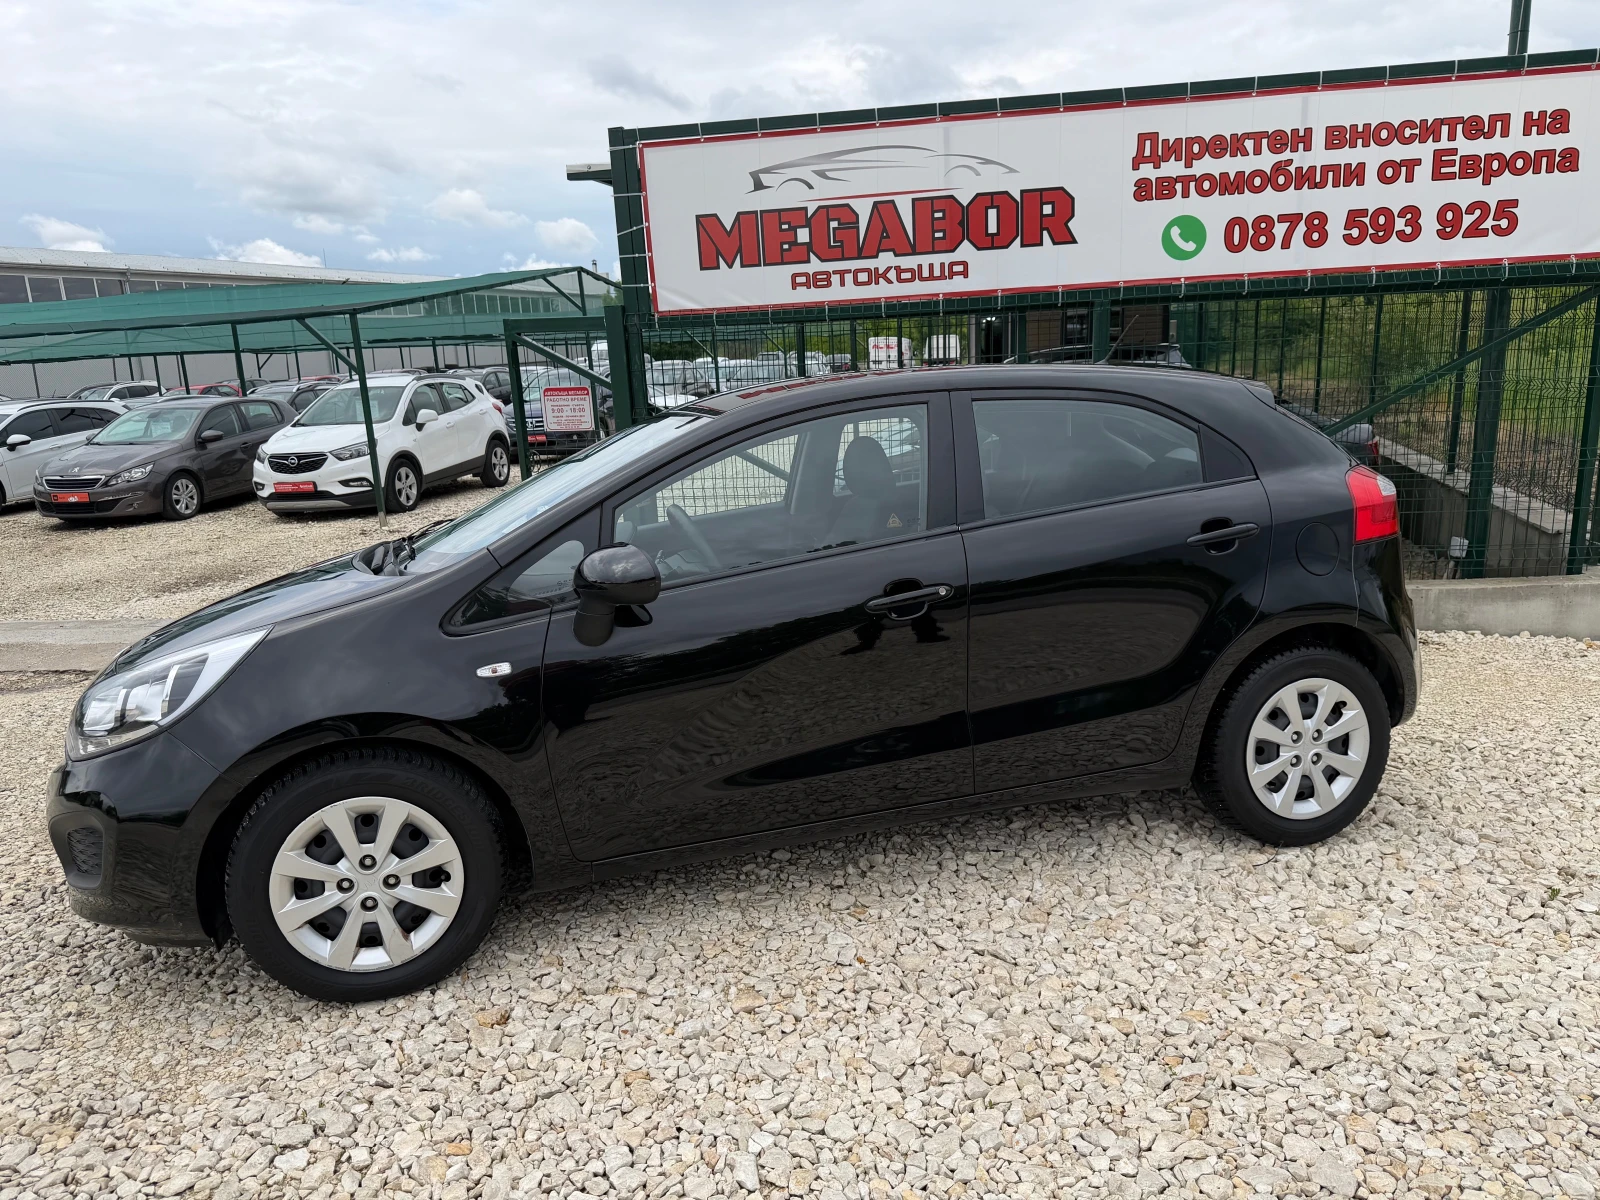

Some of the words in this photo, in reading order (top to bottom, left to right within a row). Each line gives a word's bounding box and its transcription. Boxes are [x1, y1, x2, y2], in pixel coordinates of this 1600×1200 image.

[1132, 127, 1312, 171] Директен
[1325, 113, 1511, 150] вносител
[1523, 109, 1571, 136] на
[1133, 158, 1366, 202] автомобили
[1377, 158, 1422, 185] от
[1431, 147, 1580, 186] Европа
[695, 186, 1079, 272] MEGABOR
[1224, 211, 1329, 254] 0878
[1342, 205, 1423, 246] 593
[1436, 198, 1520, 240] 925
[791, 260, 969, 291] АВТОКЪЩА
